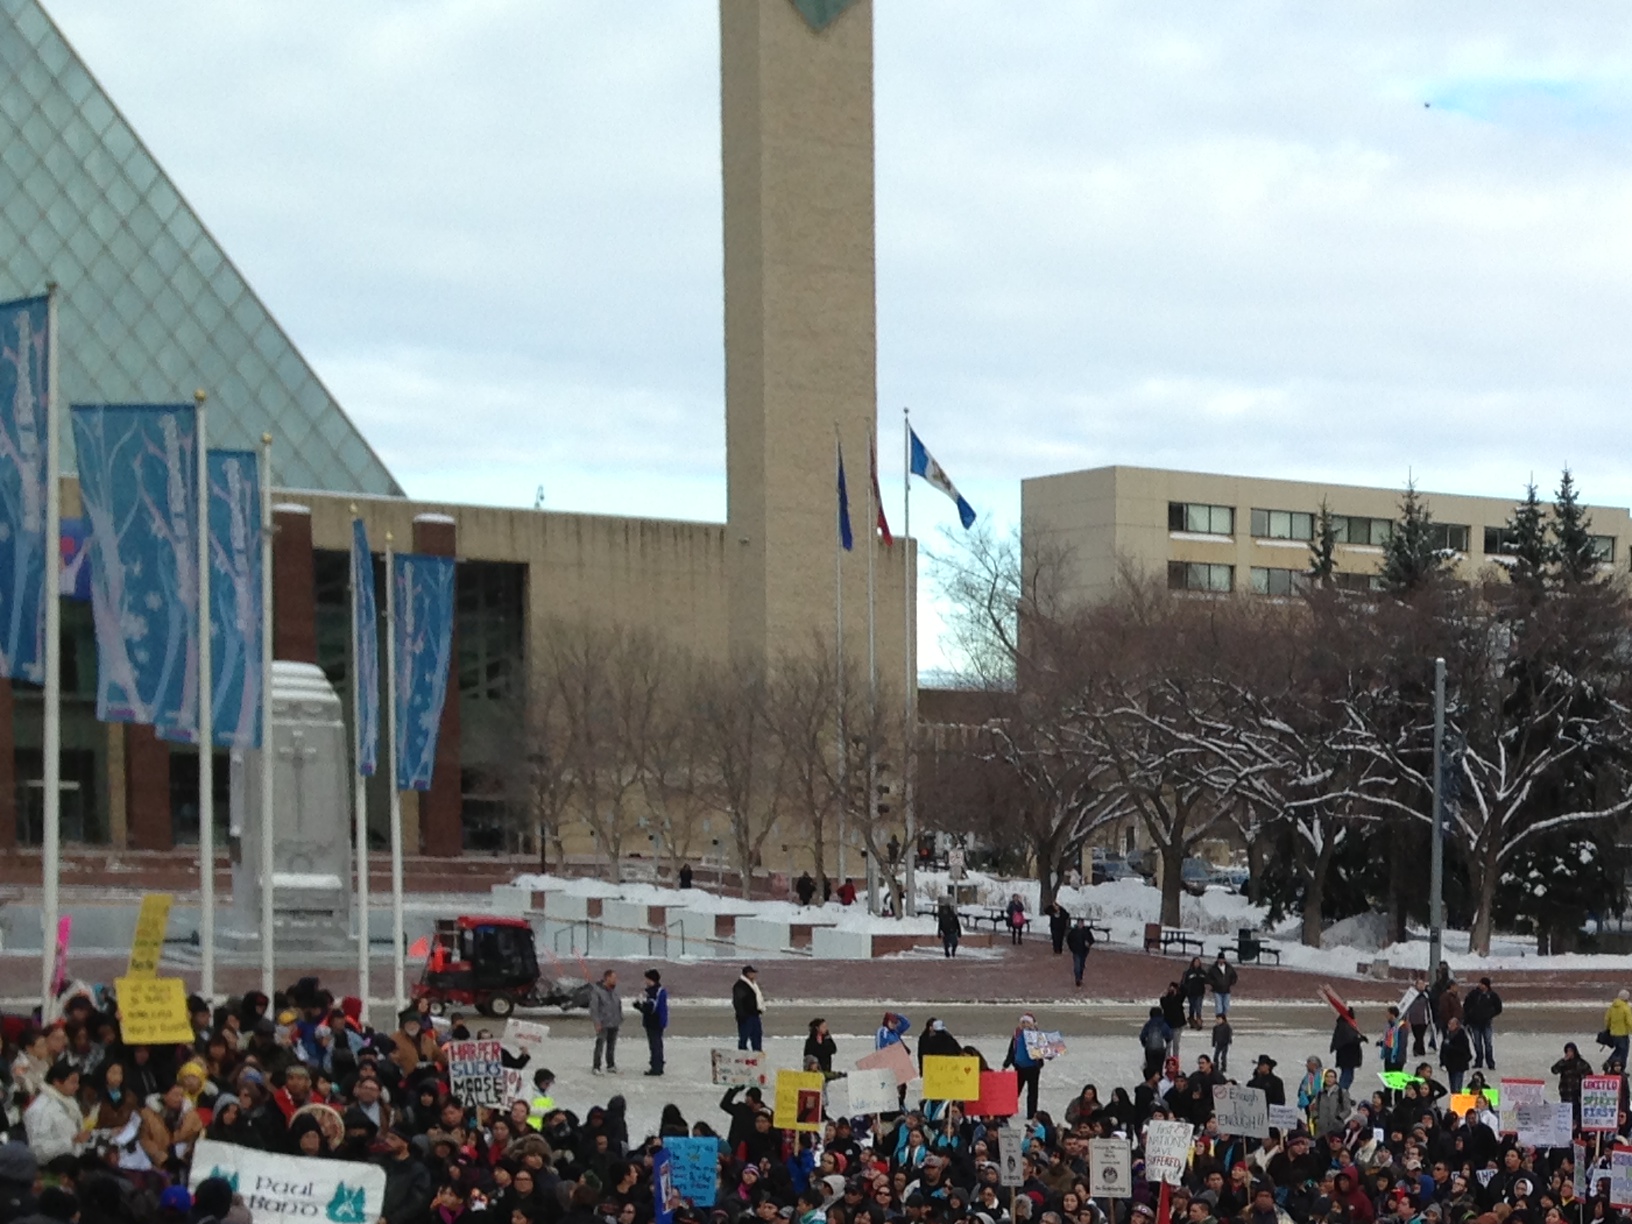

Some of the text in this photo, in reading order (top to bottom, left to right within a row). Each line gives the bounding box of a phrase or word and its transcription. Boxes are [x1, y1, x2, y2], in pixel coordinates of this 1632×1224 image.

[451, 1041, 501, 1061] HARPER
[451, 1062, 501, 1077] SUCKS
[453, 1077, 503, 1093] MOOSE
[1229, 1088, 1258, 1106] Enough
[1583, 1108, 1616, 1117] FIRST
[1149, 1135, 1187, 1148] NATIONS
[1147, 1155, 1181, 1168] SUFFERED
[255, 1175, 314, 1196] Paul
